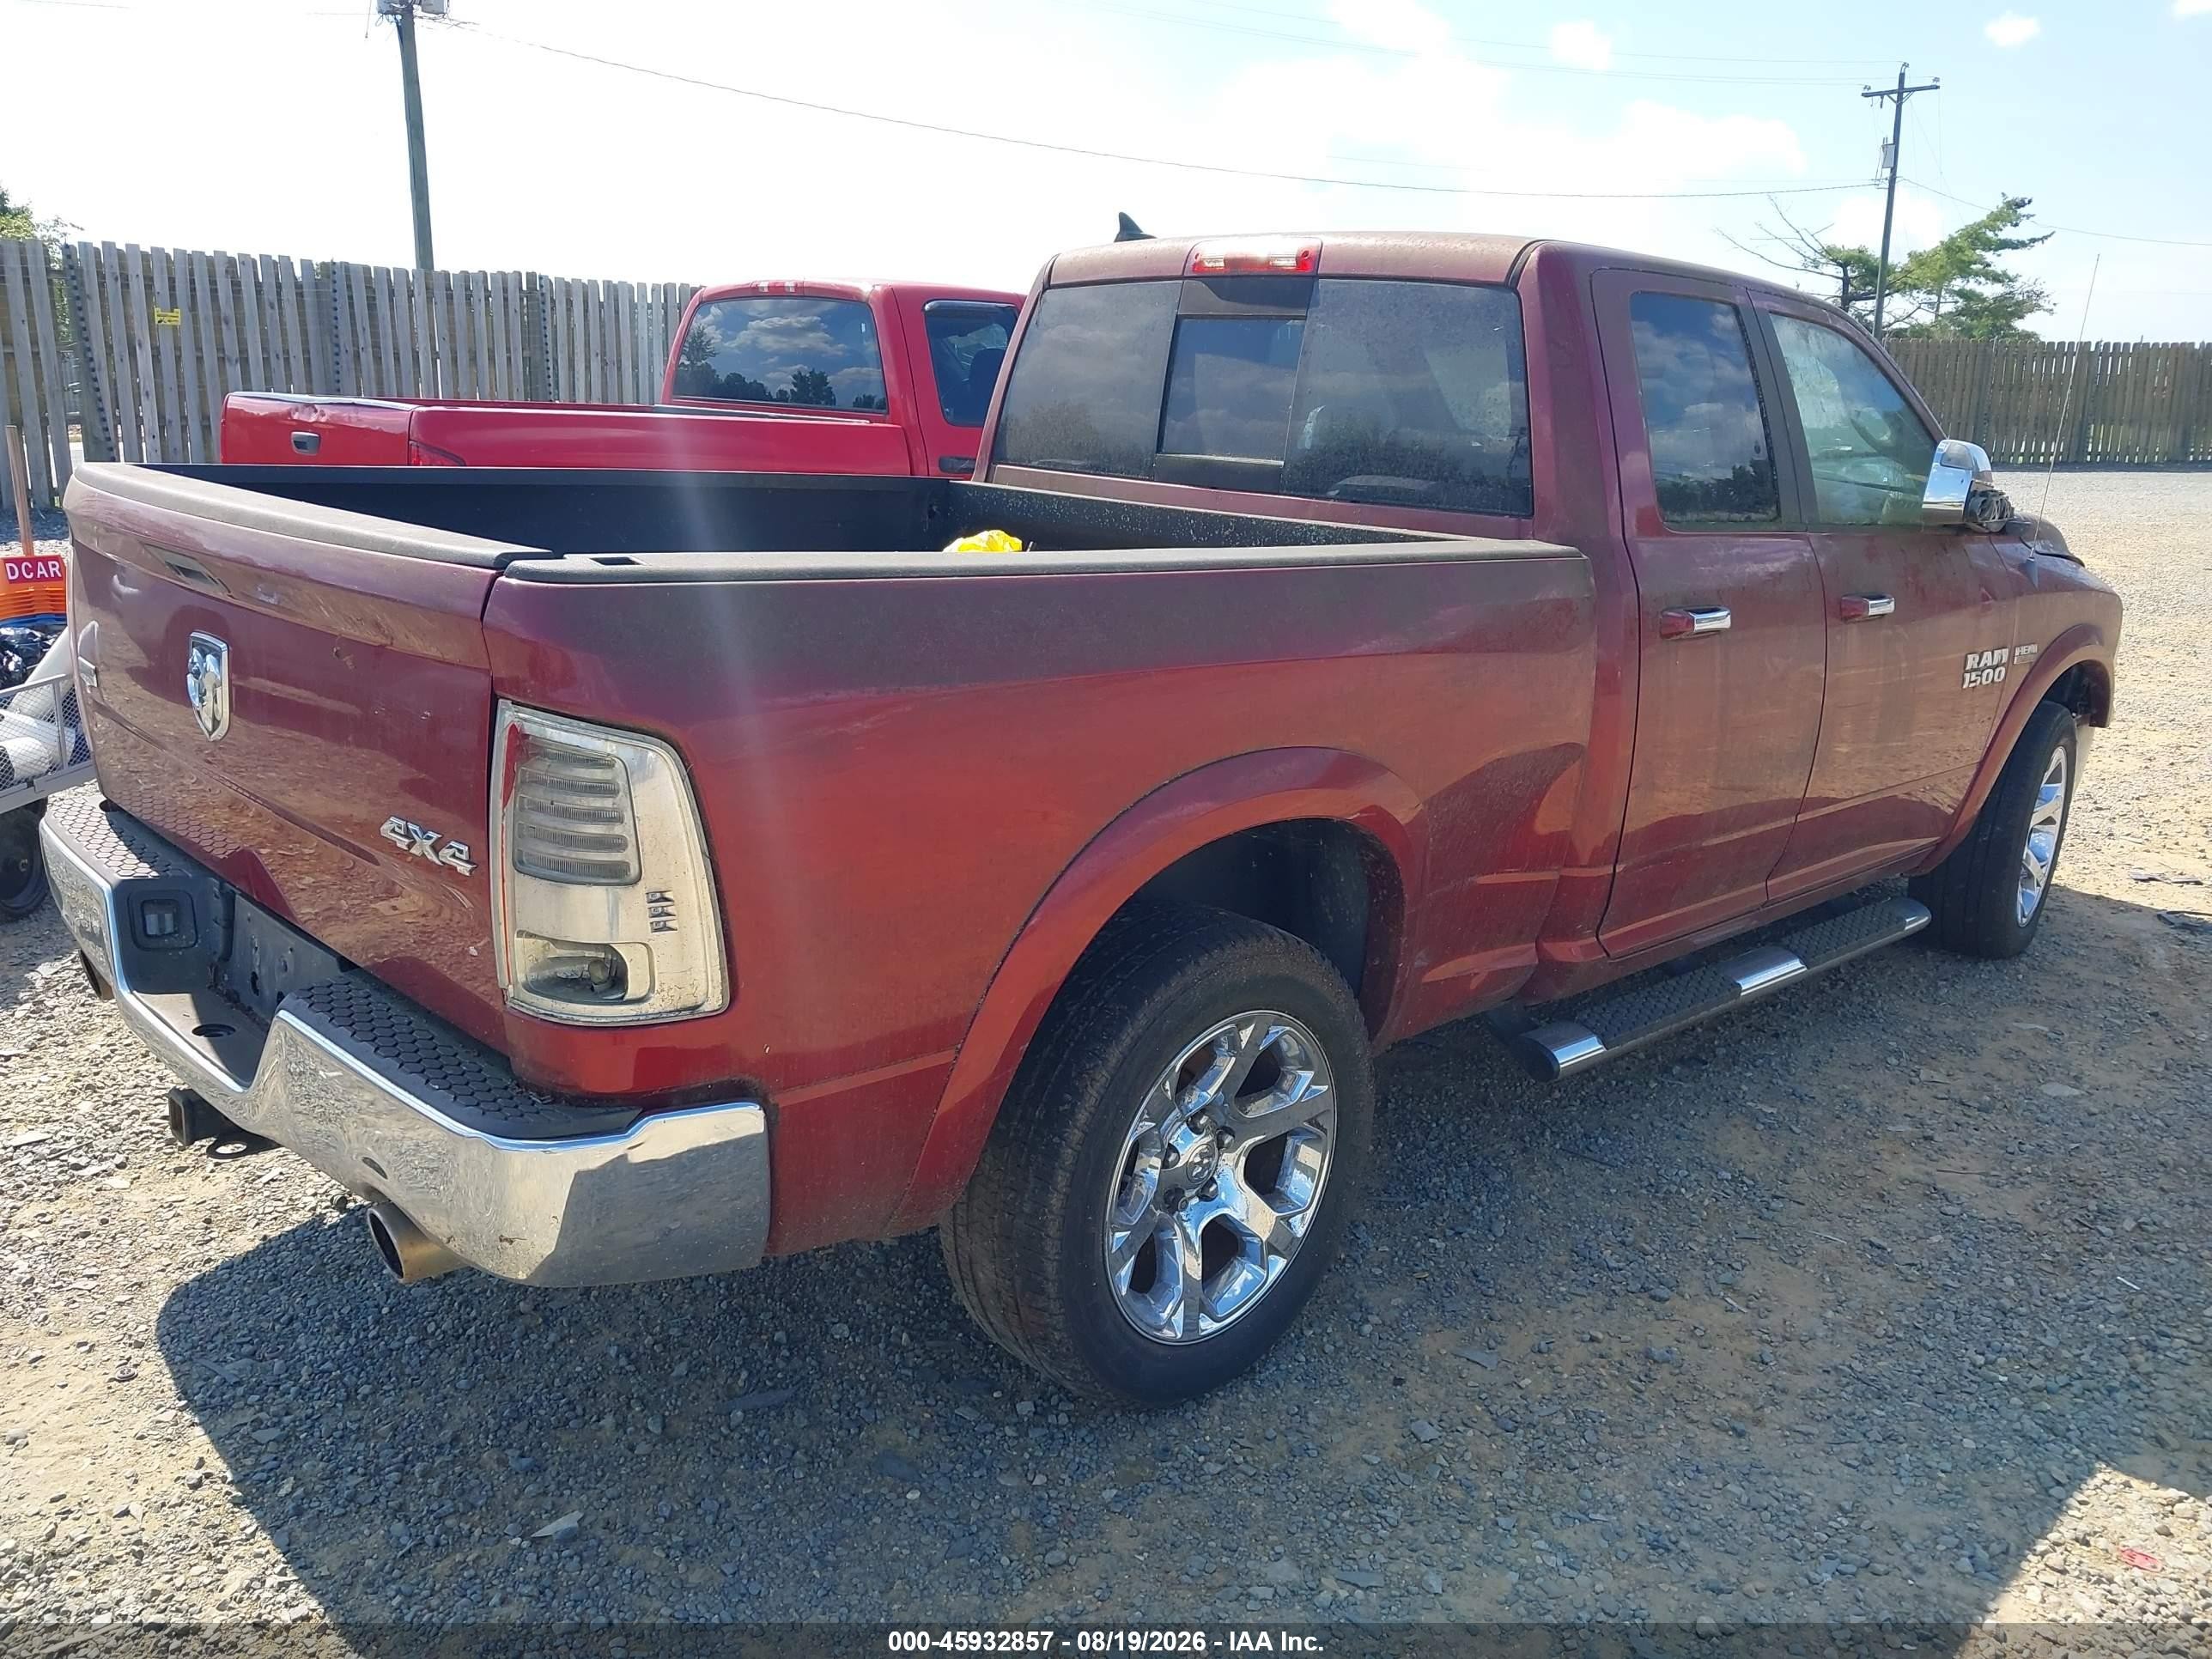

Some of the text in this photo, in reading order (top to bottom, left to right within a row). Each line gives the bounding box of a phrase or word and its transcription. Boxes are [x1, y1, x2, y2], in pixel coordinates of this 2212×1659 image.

[5, 560, 62, 580] DCAR
[1965, 648, 2009, 671] RAM
[1962, 665, 2006, 689] 1500
